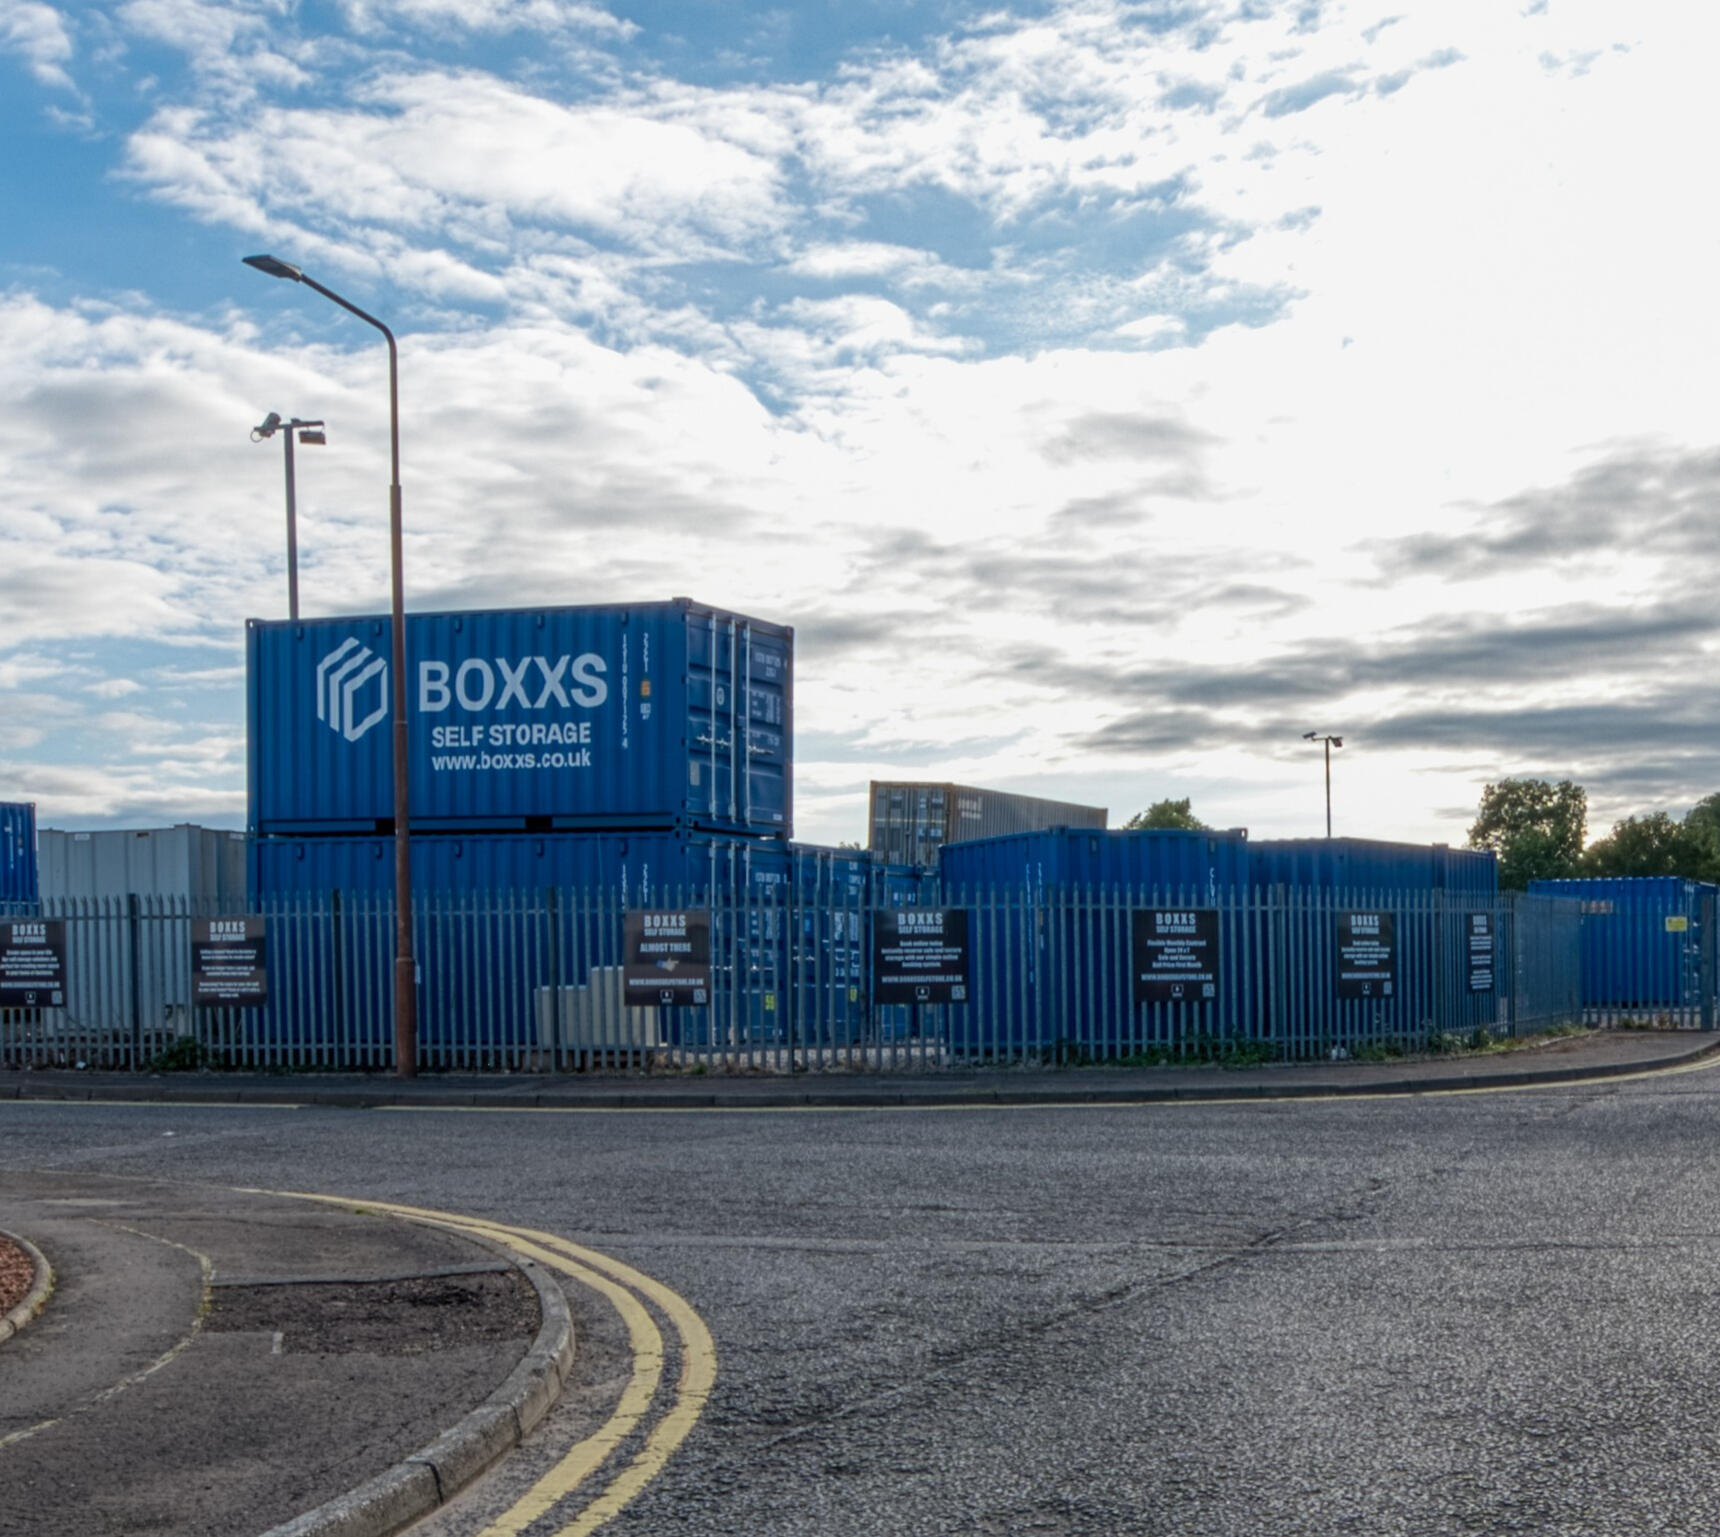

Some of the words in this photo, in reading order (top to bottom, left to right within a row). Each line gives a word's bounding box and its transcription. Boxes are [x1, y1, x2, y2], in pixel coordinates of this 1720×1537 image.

[419, 653, 608, 712] BOXXS
[432, 726, 484, 748] SELF
[488, 722, 591, 746] STORAGE
[432, 748, 591, 771] www.boxxs.co.uk
[644, 914, 686, 927] BOXXS
[898, 912, 943, 925] BOXXS
[1156, 912, 1196, 925] BOXXS
[1351, 915, 1379, 926] BOXXS
[12, 924, 46, 936] BOXXS
[210, 921, 246, 933] BOXXS
[644, 928, 657, 936] SELF
[658, 928, 686, 936] STORAGE
[640, 942, 668, 952] ALMOST
[670, 942, 692, 952] THERE
